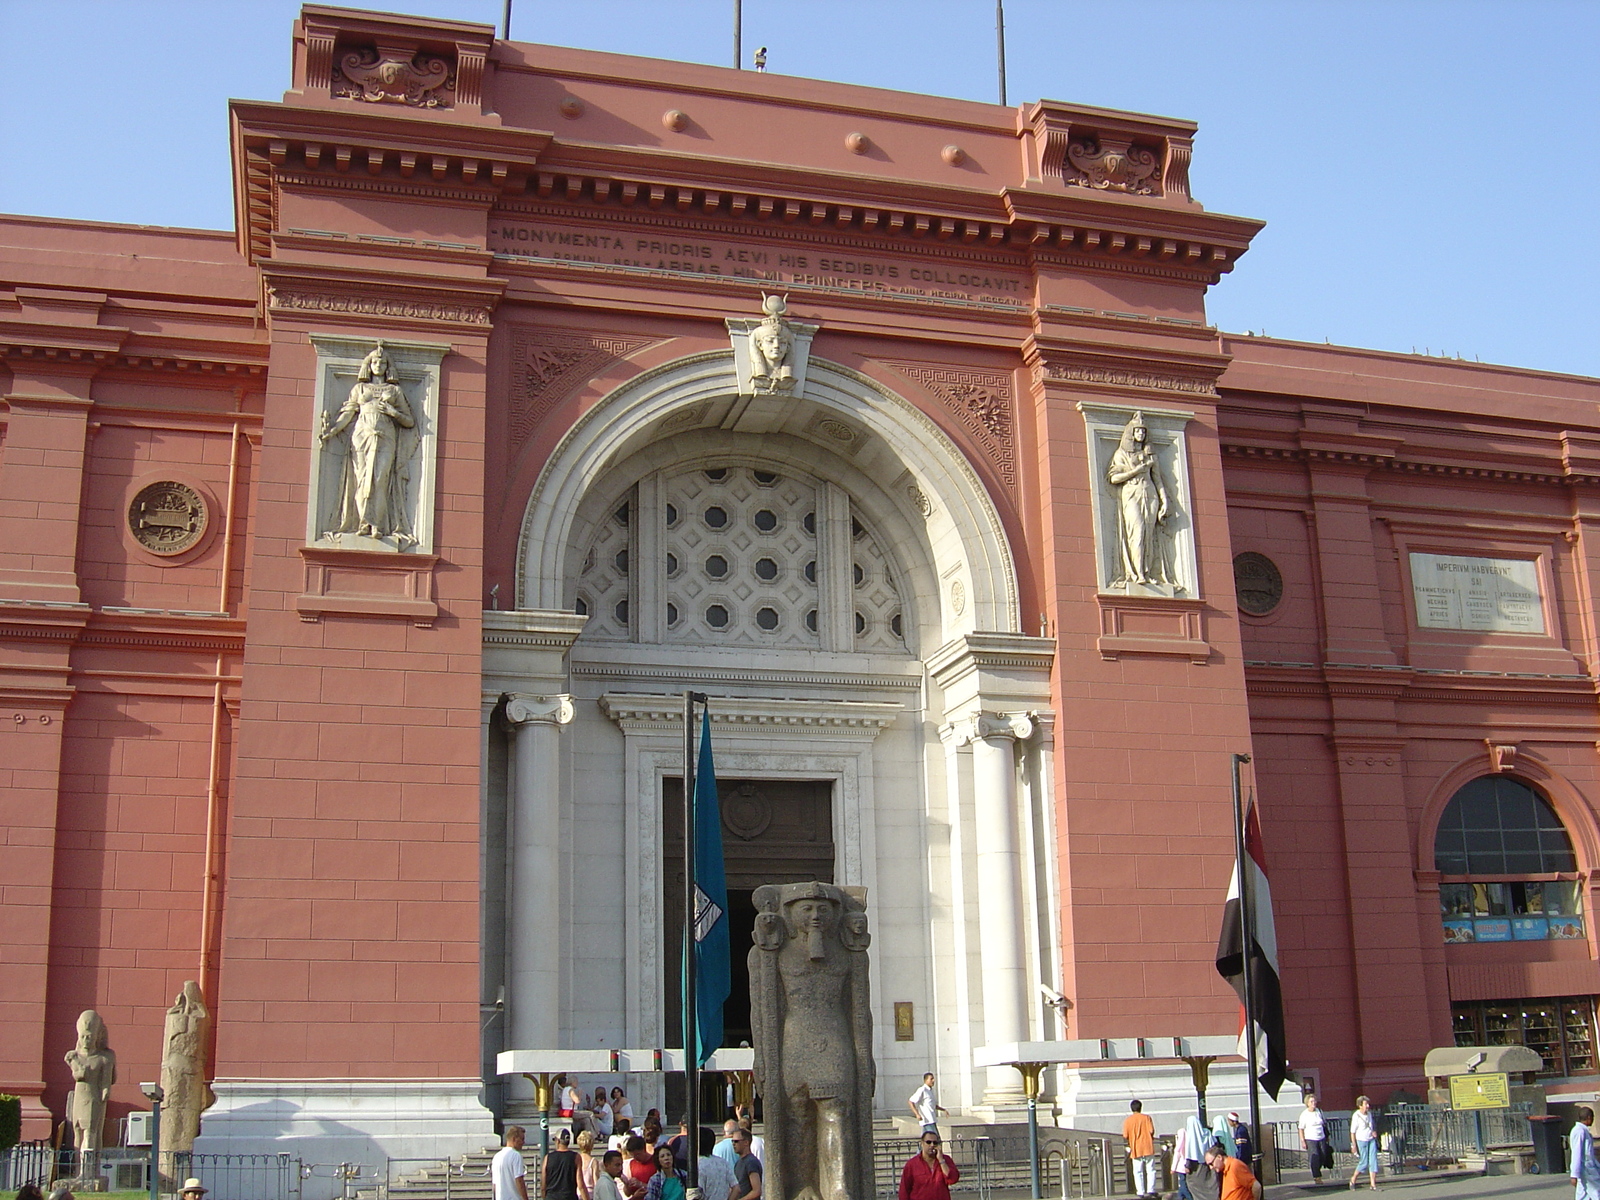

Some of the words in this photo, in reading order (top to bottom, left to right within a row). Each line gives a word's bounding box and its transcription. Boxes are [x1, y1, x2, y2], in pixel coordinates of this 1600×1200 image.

[502, 227, 624, 250] MONVMENTA
[636, 240, 713, 259] PRIORIS
[724, 249, 768, 264] AEVI
[778, 254, 808, 269] HIS
[819, 258, 899, 278] SEDIBVS
[910, 268, 1020, 292] COLLOCAVIT
[791, 273, 886, 292] PRINCEPS
[1436, 563, 1469, 573] IMPERIVM
[1471, 565, 1511, 575] HABVERVNT
